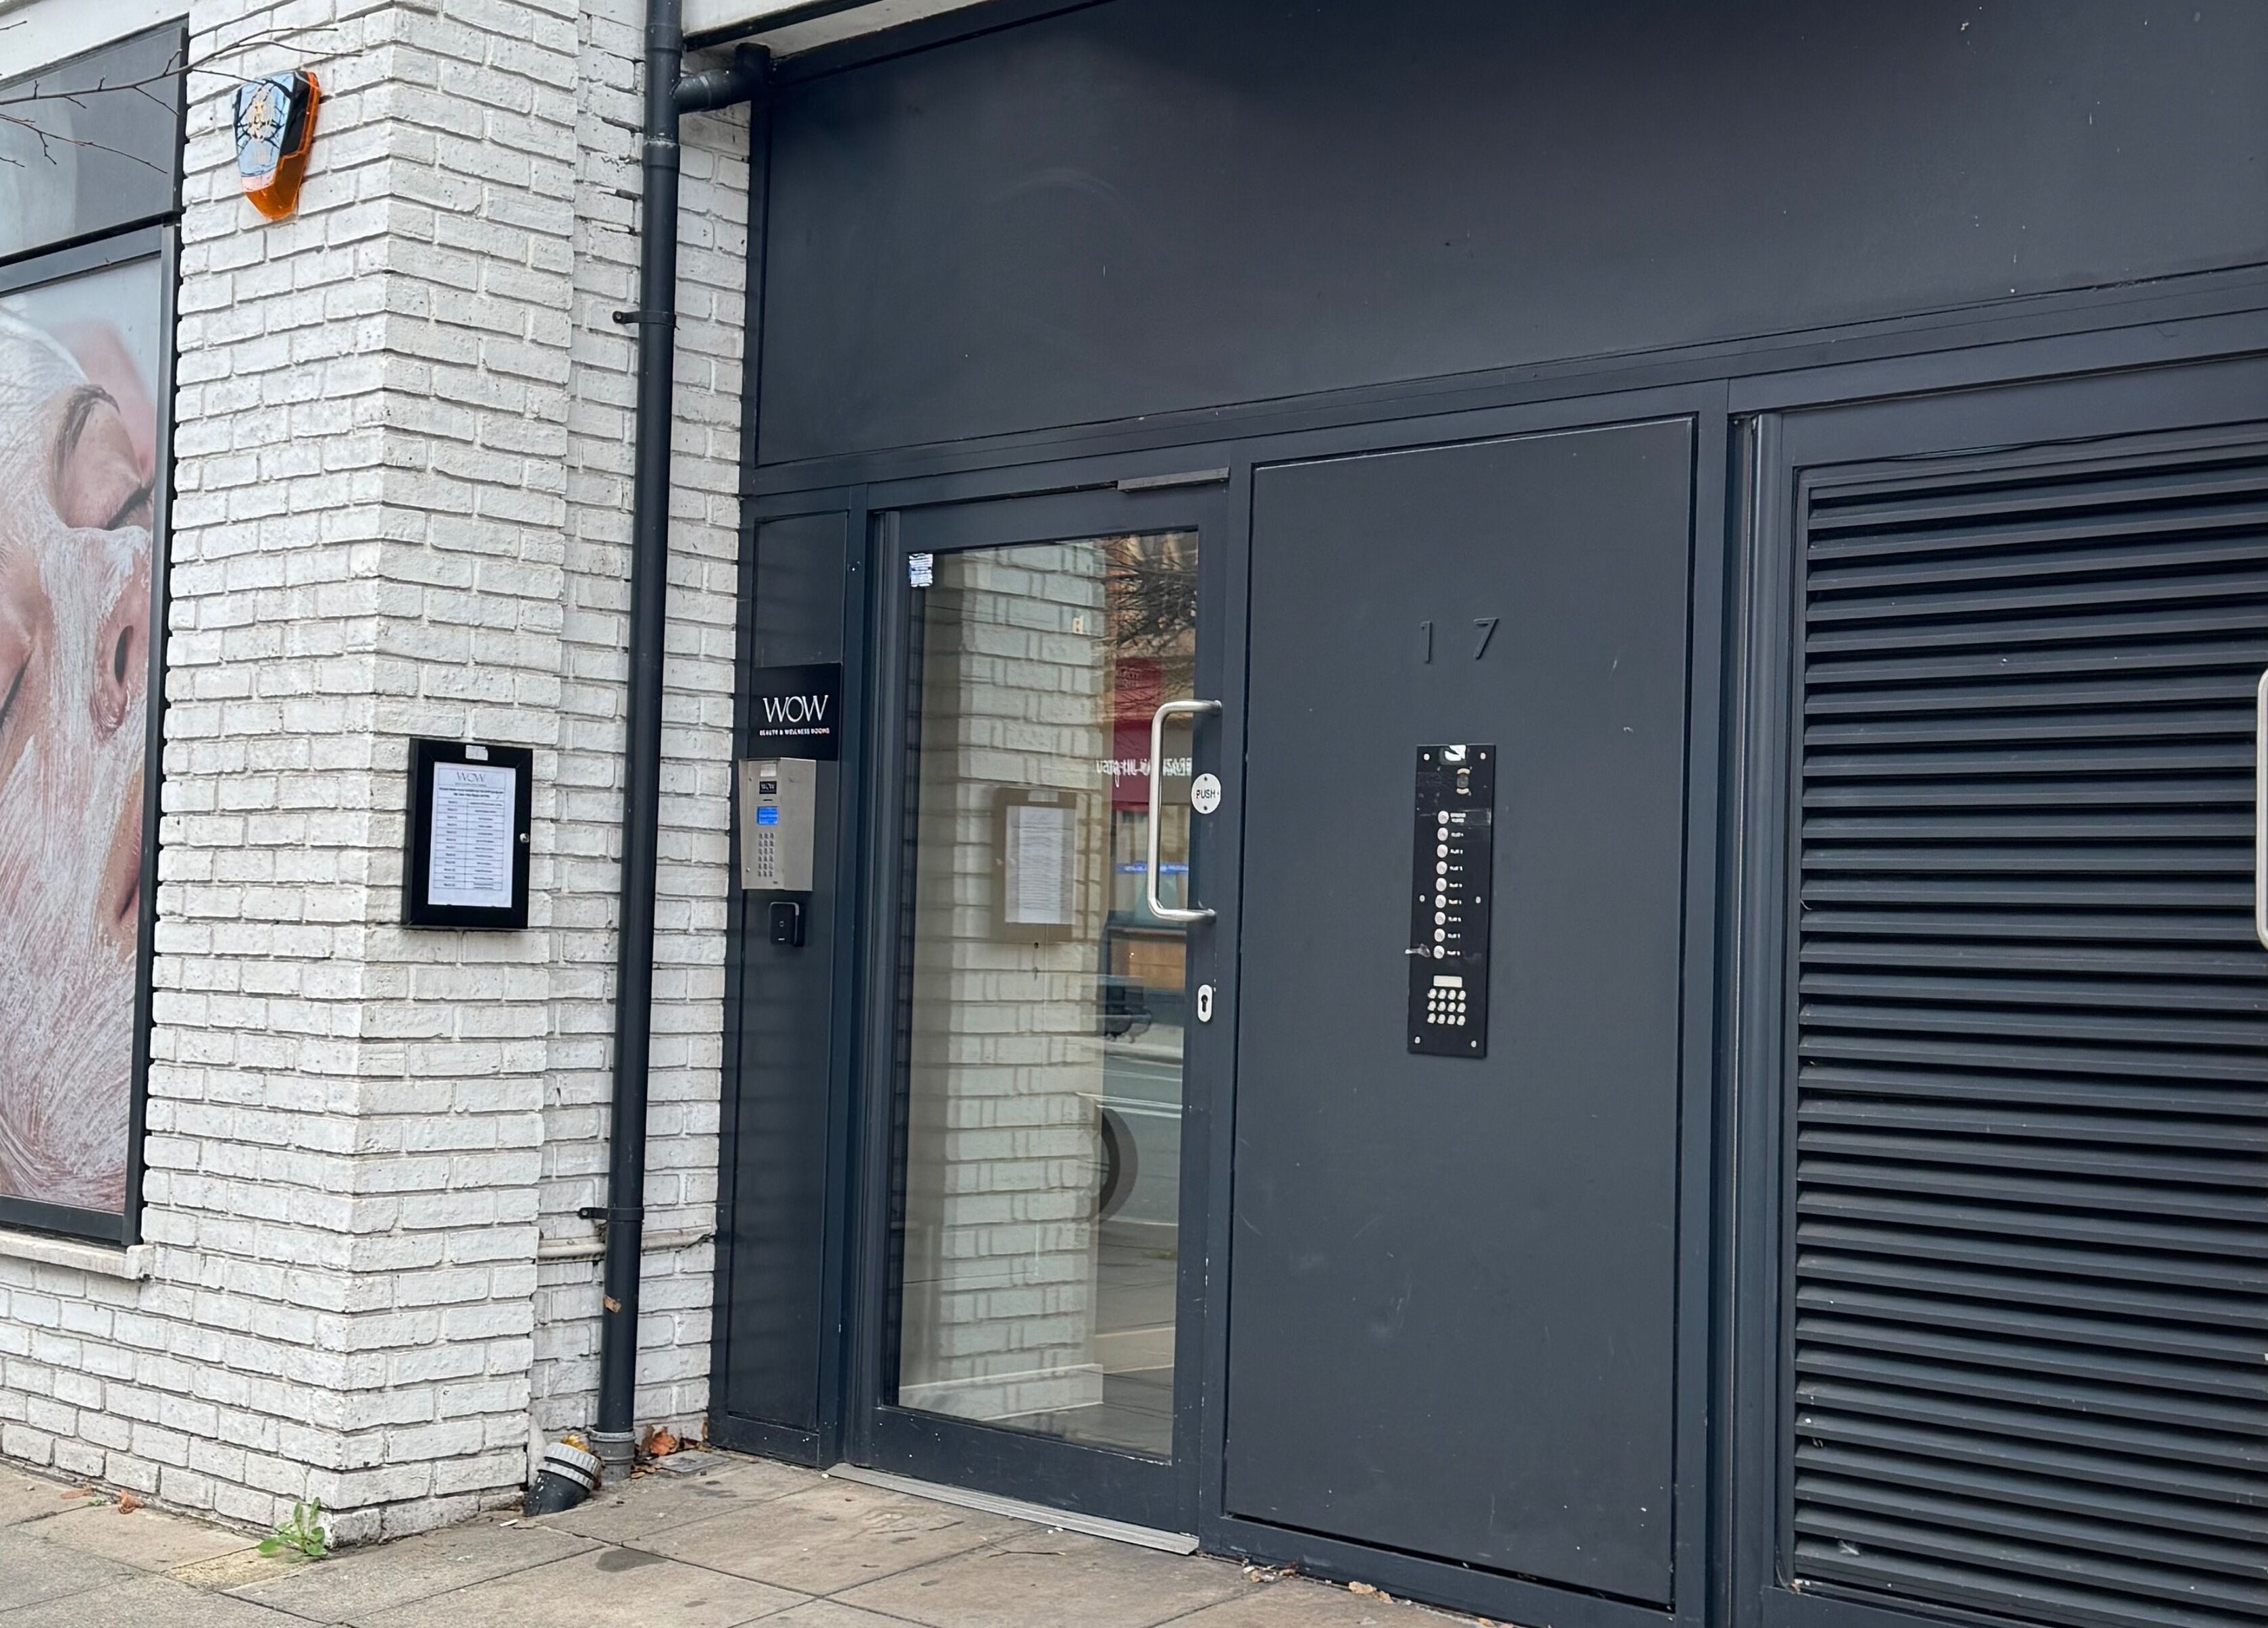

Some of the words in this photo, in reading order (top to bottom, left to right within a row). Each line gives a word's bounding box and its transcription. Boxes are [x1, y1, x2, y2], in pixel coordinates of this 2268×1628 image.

[1420, 617, 1499, 664] 17
[763, 695, 829, 722] WOW
[456, 772, 486, 782] WOW
[1196, 789, 1216, 799] PUSH
